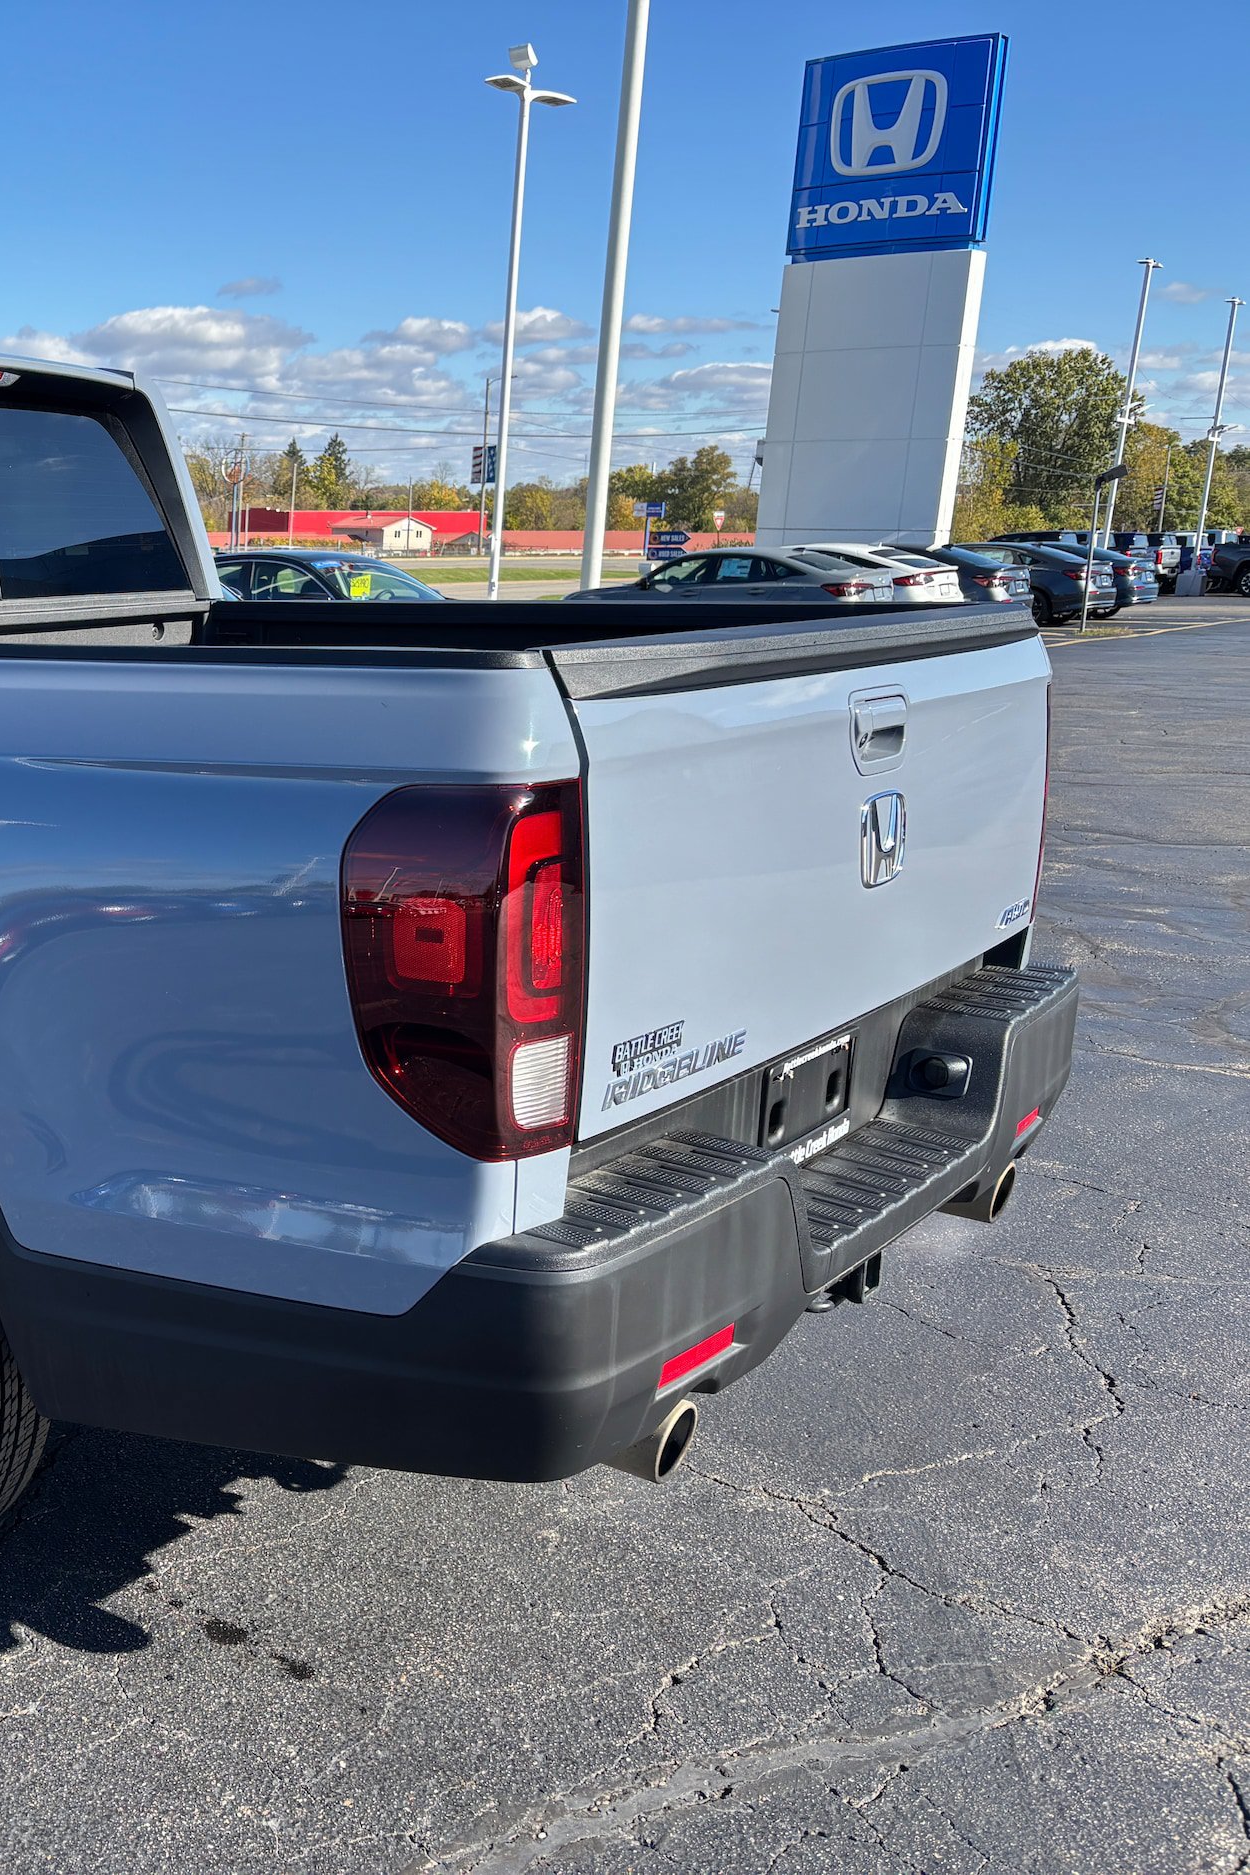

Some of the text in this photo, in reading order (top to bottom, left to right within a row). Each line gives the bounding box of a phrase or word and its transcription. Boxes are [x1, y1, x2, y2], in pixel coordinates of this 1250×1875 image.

[795, 192, 968, 229] HONDA
[614, 1021, 685, 1064] BATTLE CREEK
[633, 1044, 678, 1070] HONDA
[600, 1028, 747, 1112] RIDGELINE
